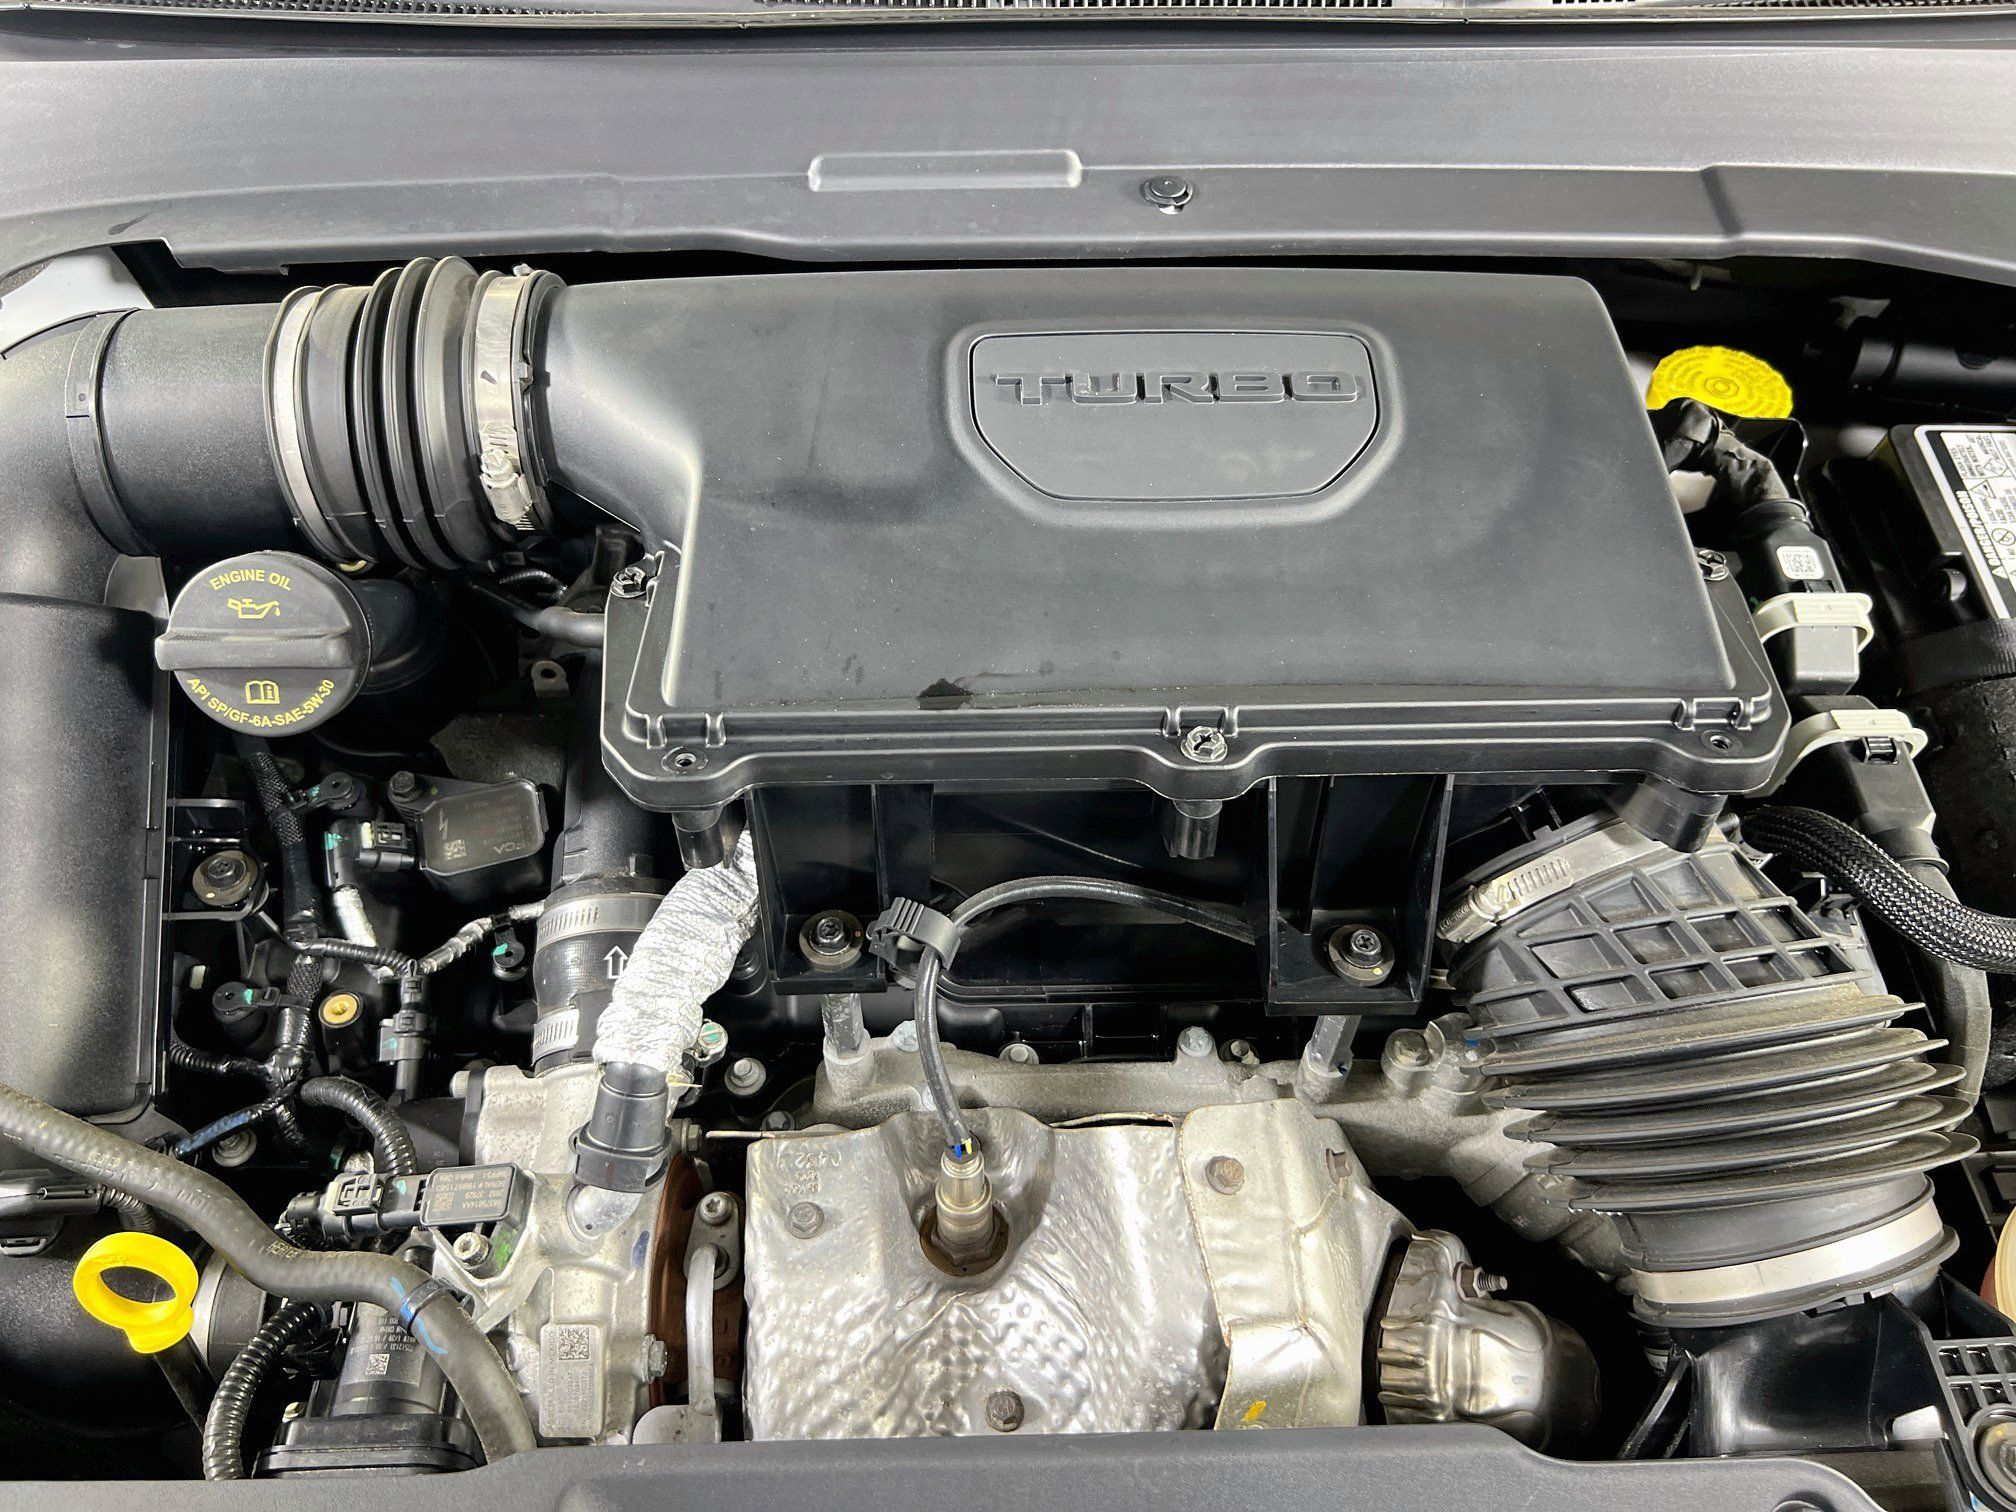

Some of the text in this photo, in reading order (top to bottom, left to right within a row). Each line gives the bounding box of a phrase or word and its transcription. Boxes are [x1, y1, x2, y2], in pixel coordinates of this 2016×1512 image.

[995, 369, 1361, 406] TURBO
[1956, 491, 2002, 567] DANGER/POISON
[208, 568, 293, 592] ENGINE OIL
[187, 677, 336, 728] API SP/GF-6A-SAE-5W-30
